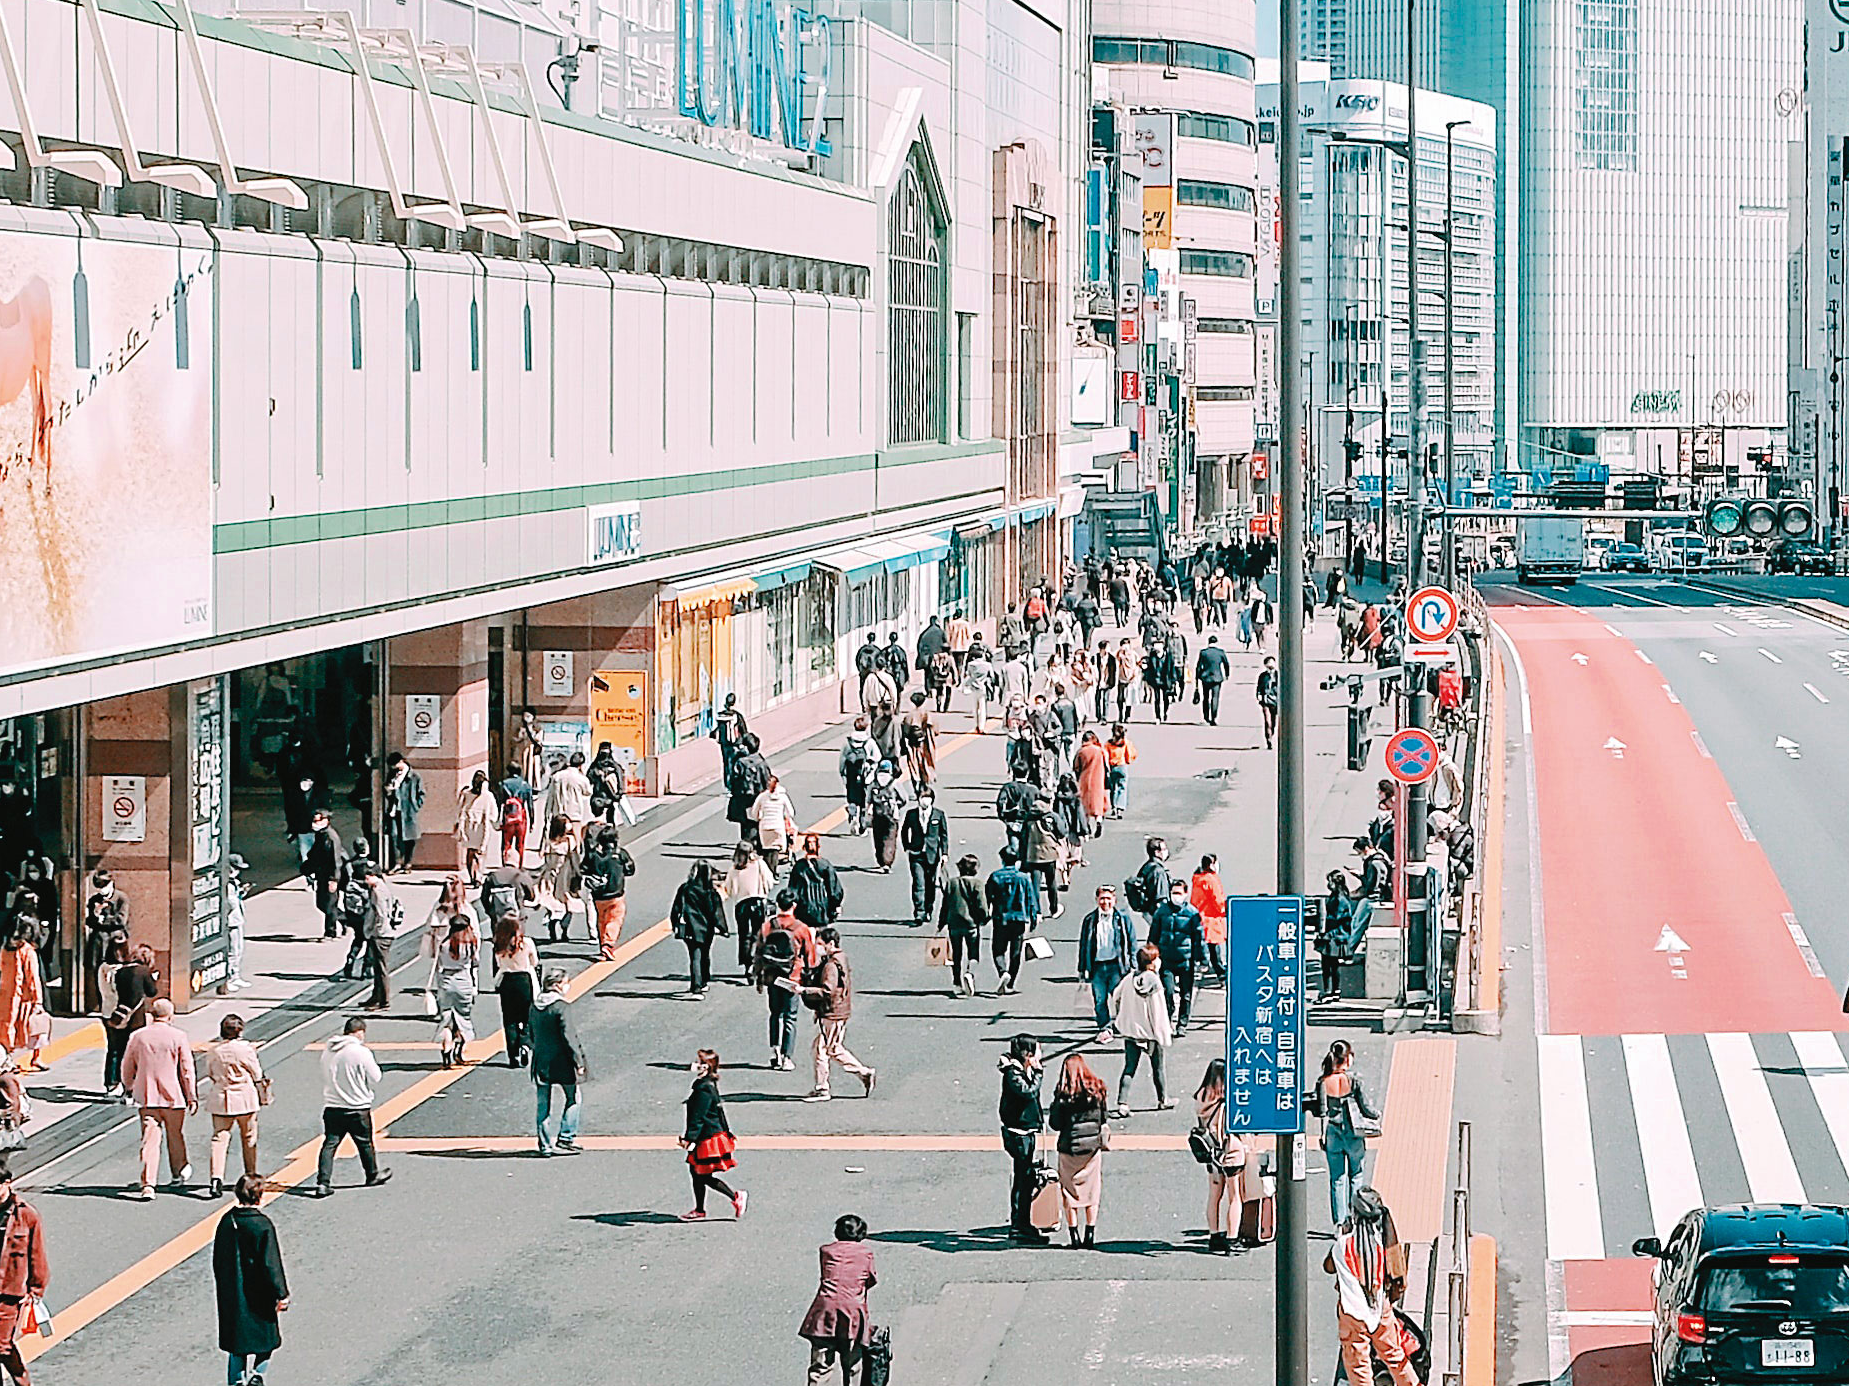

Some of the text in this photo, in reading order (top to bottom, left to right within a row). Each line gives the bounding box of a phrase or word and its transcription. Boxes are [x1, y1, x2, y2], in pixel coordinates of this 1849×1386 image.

[1233, 1026, 1252, 1127] 入れません
[1255, 944, 1274, 1086] バスタ新宿へは
[1276, 907, 1297, 1111] 一般車・原付・自転車は
